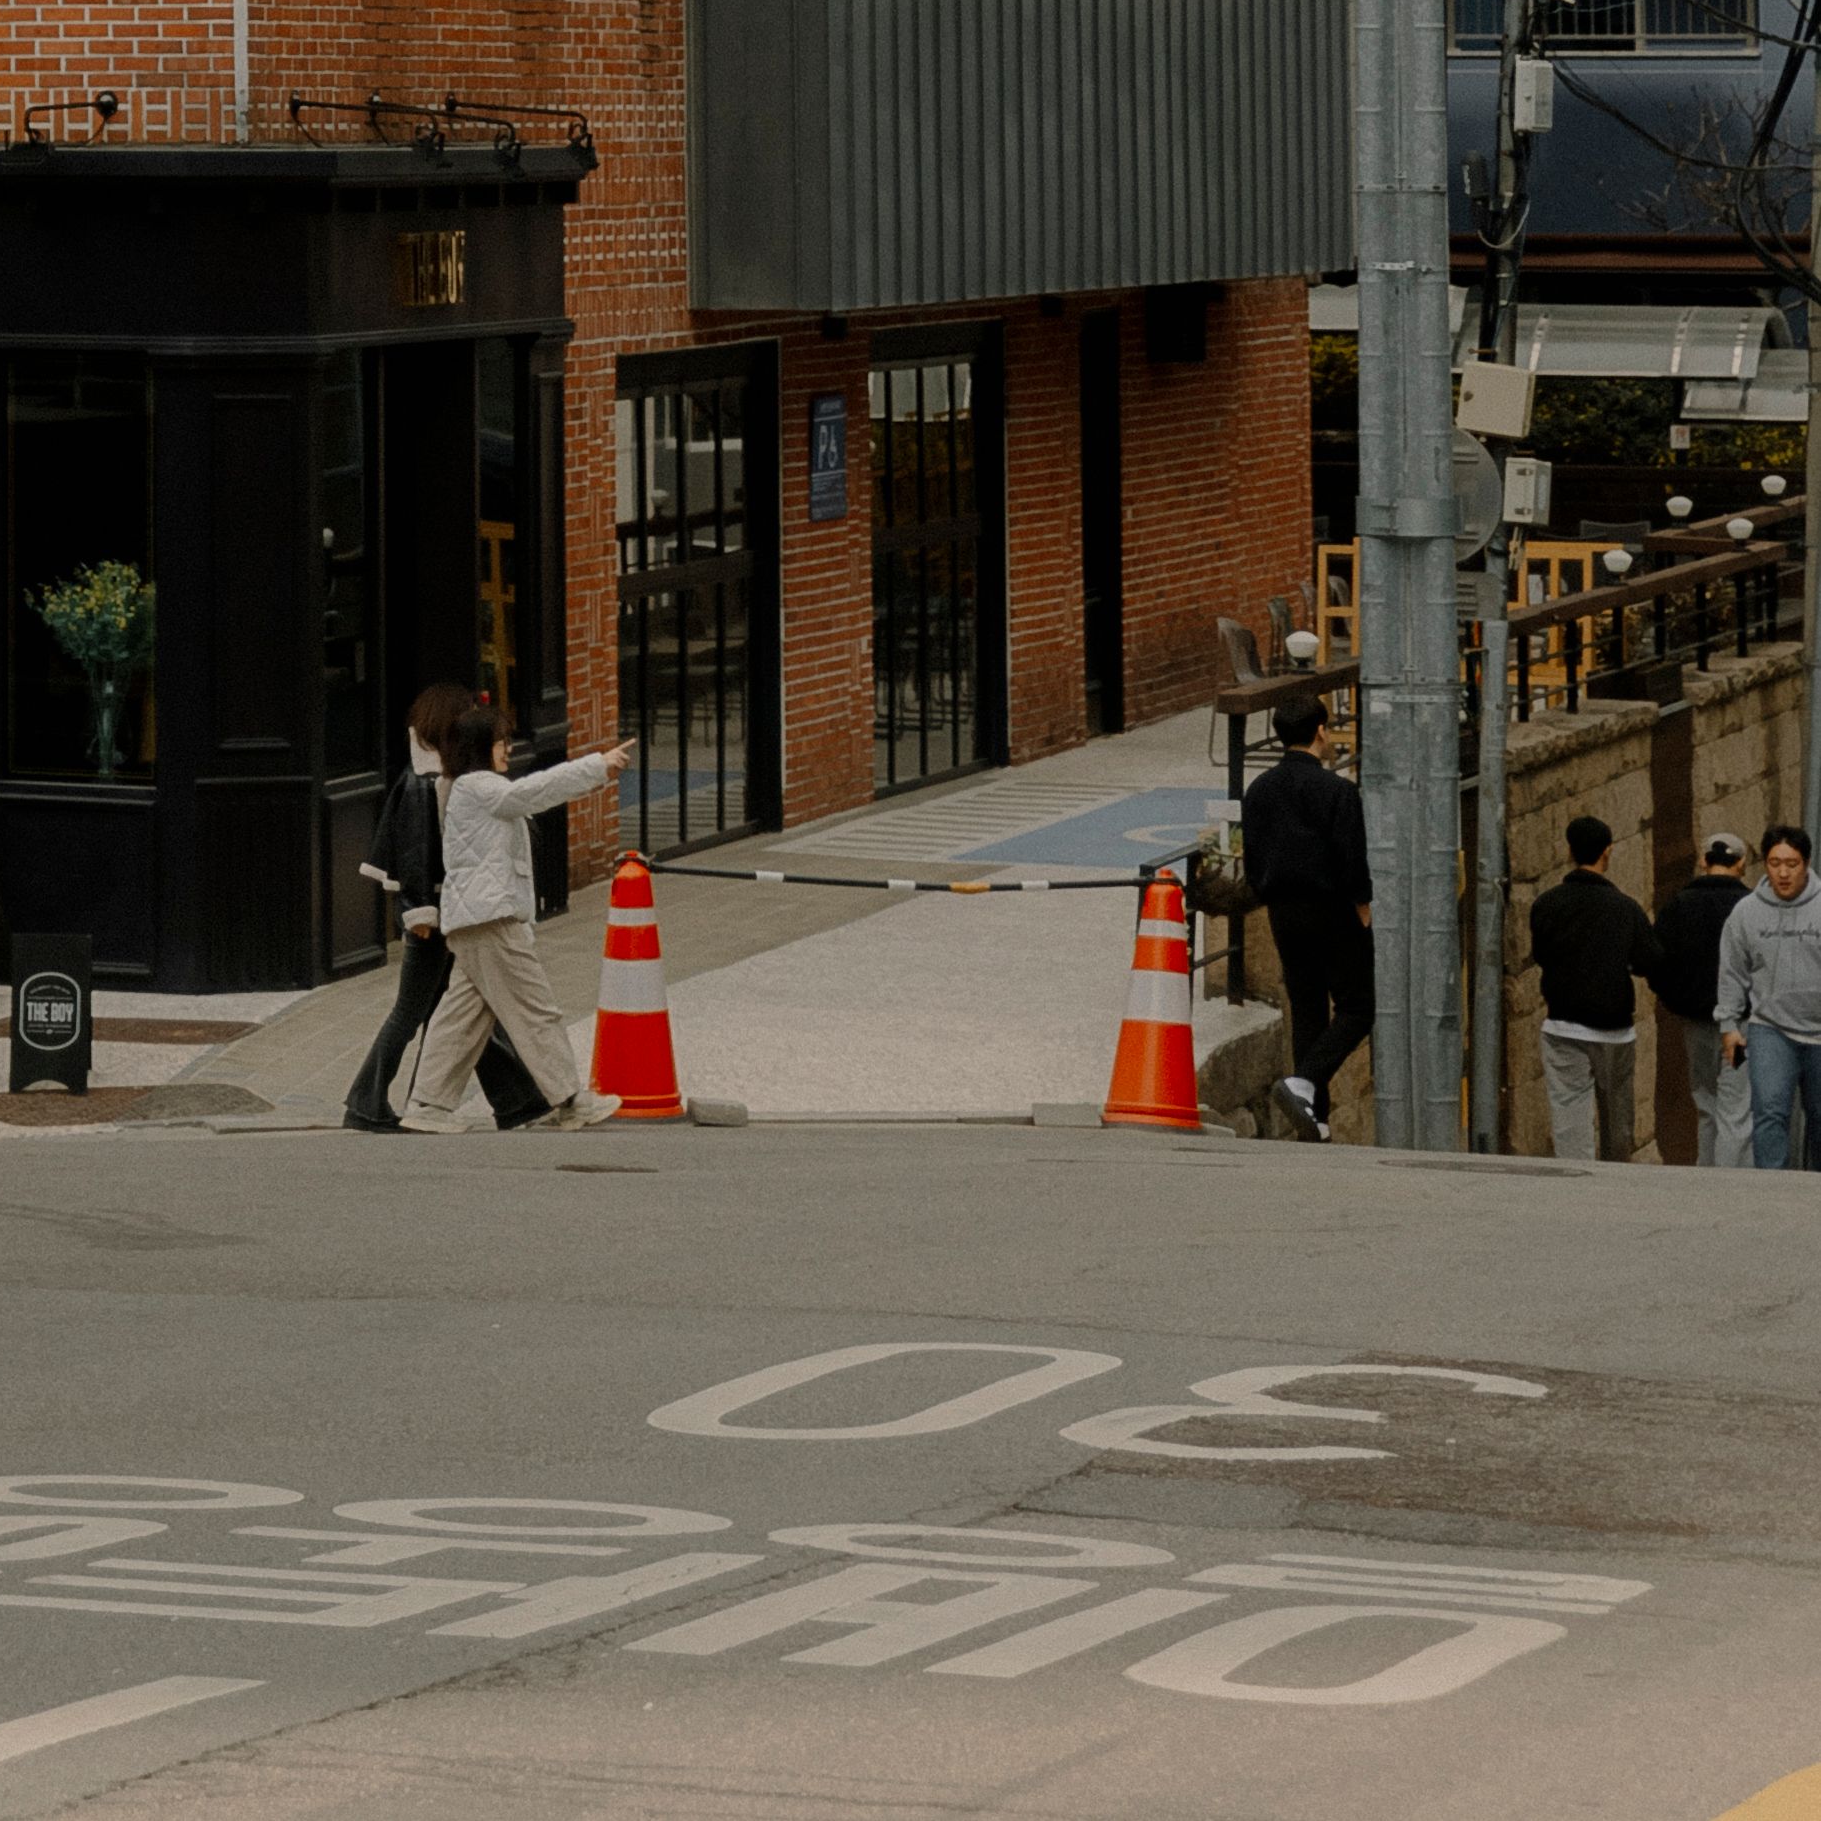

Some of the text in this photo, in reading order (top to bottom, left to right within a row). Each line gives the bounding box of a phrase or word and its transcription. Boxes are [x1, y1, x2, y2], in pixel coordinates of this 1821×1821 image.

[396, 229, 467, 307] THE BOY
[26, 1001, 75, 1023] THE BOY
[644, 1340, 1550, 1462] 30
